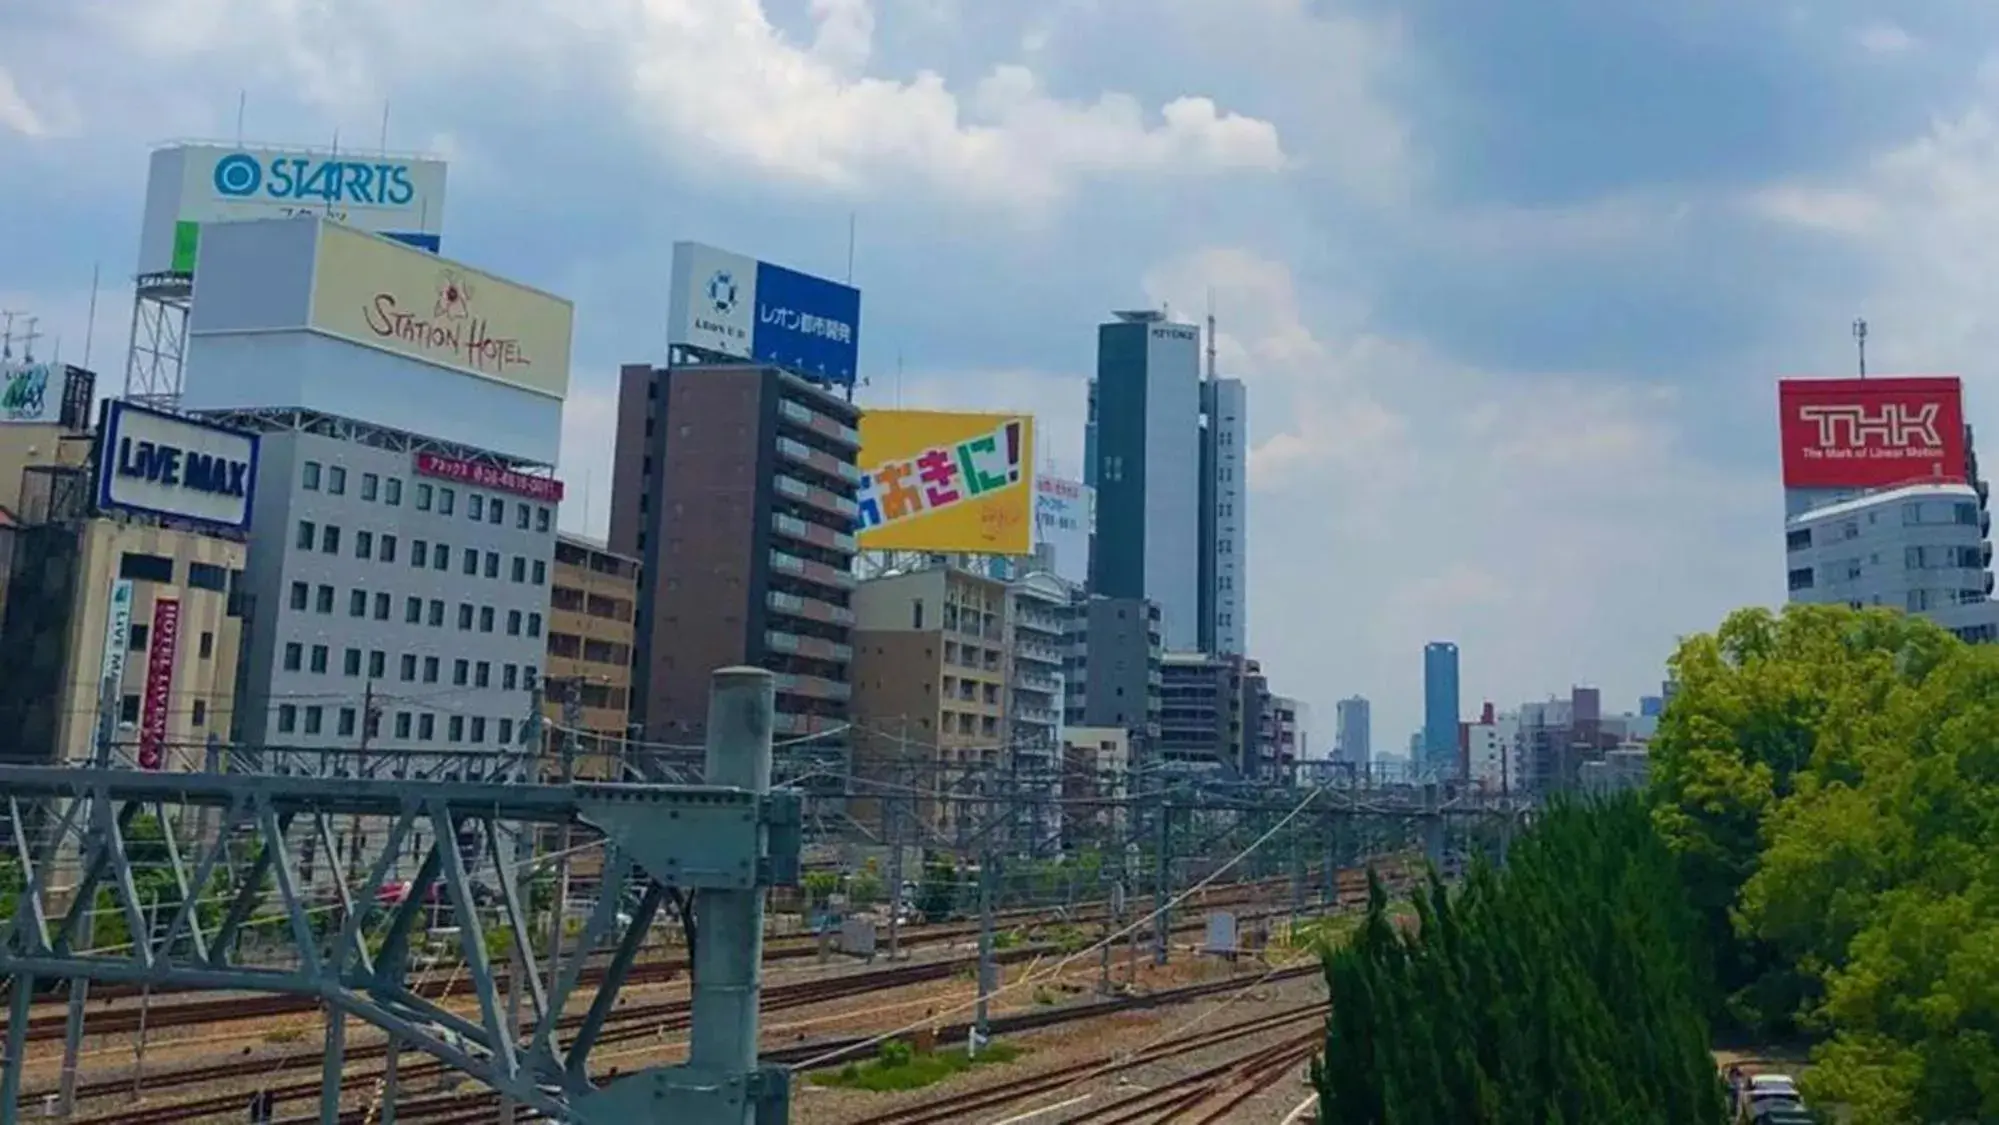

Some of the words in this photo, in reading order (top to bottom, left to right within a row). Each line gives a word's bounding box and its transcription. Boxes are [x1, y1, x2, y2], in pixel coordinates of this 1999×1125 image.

[267, 158, 414, 204] STARTS
[760, 303, 851, 344] レオン都市開発
[1800, 404, 1942, 446] THK
[184, 451, 247, 497] MAX
[1803, 447, 1823, 459] The
[1825, 447, 1852, 458] Mark
[1854, 447, 1867, 458] of
[1870, 447, 1904, 458] Linear
[1906, 447, 1945, 458] Motion
